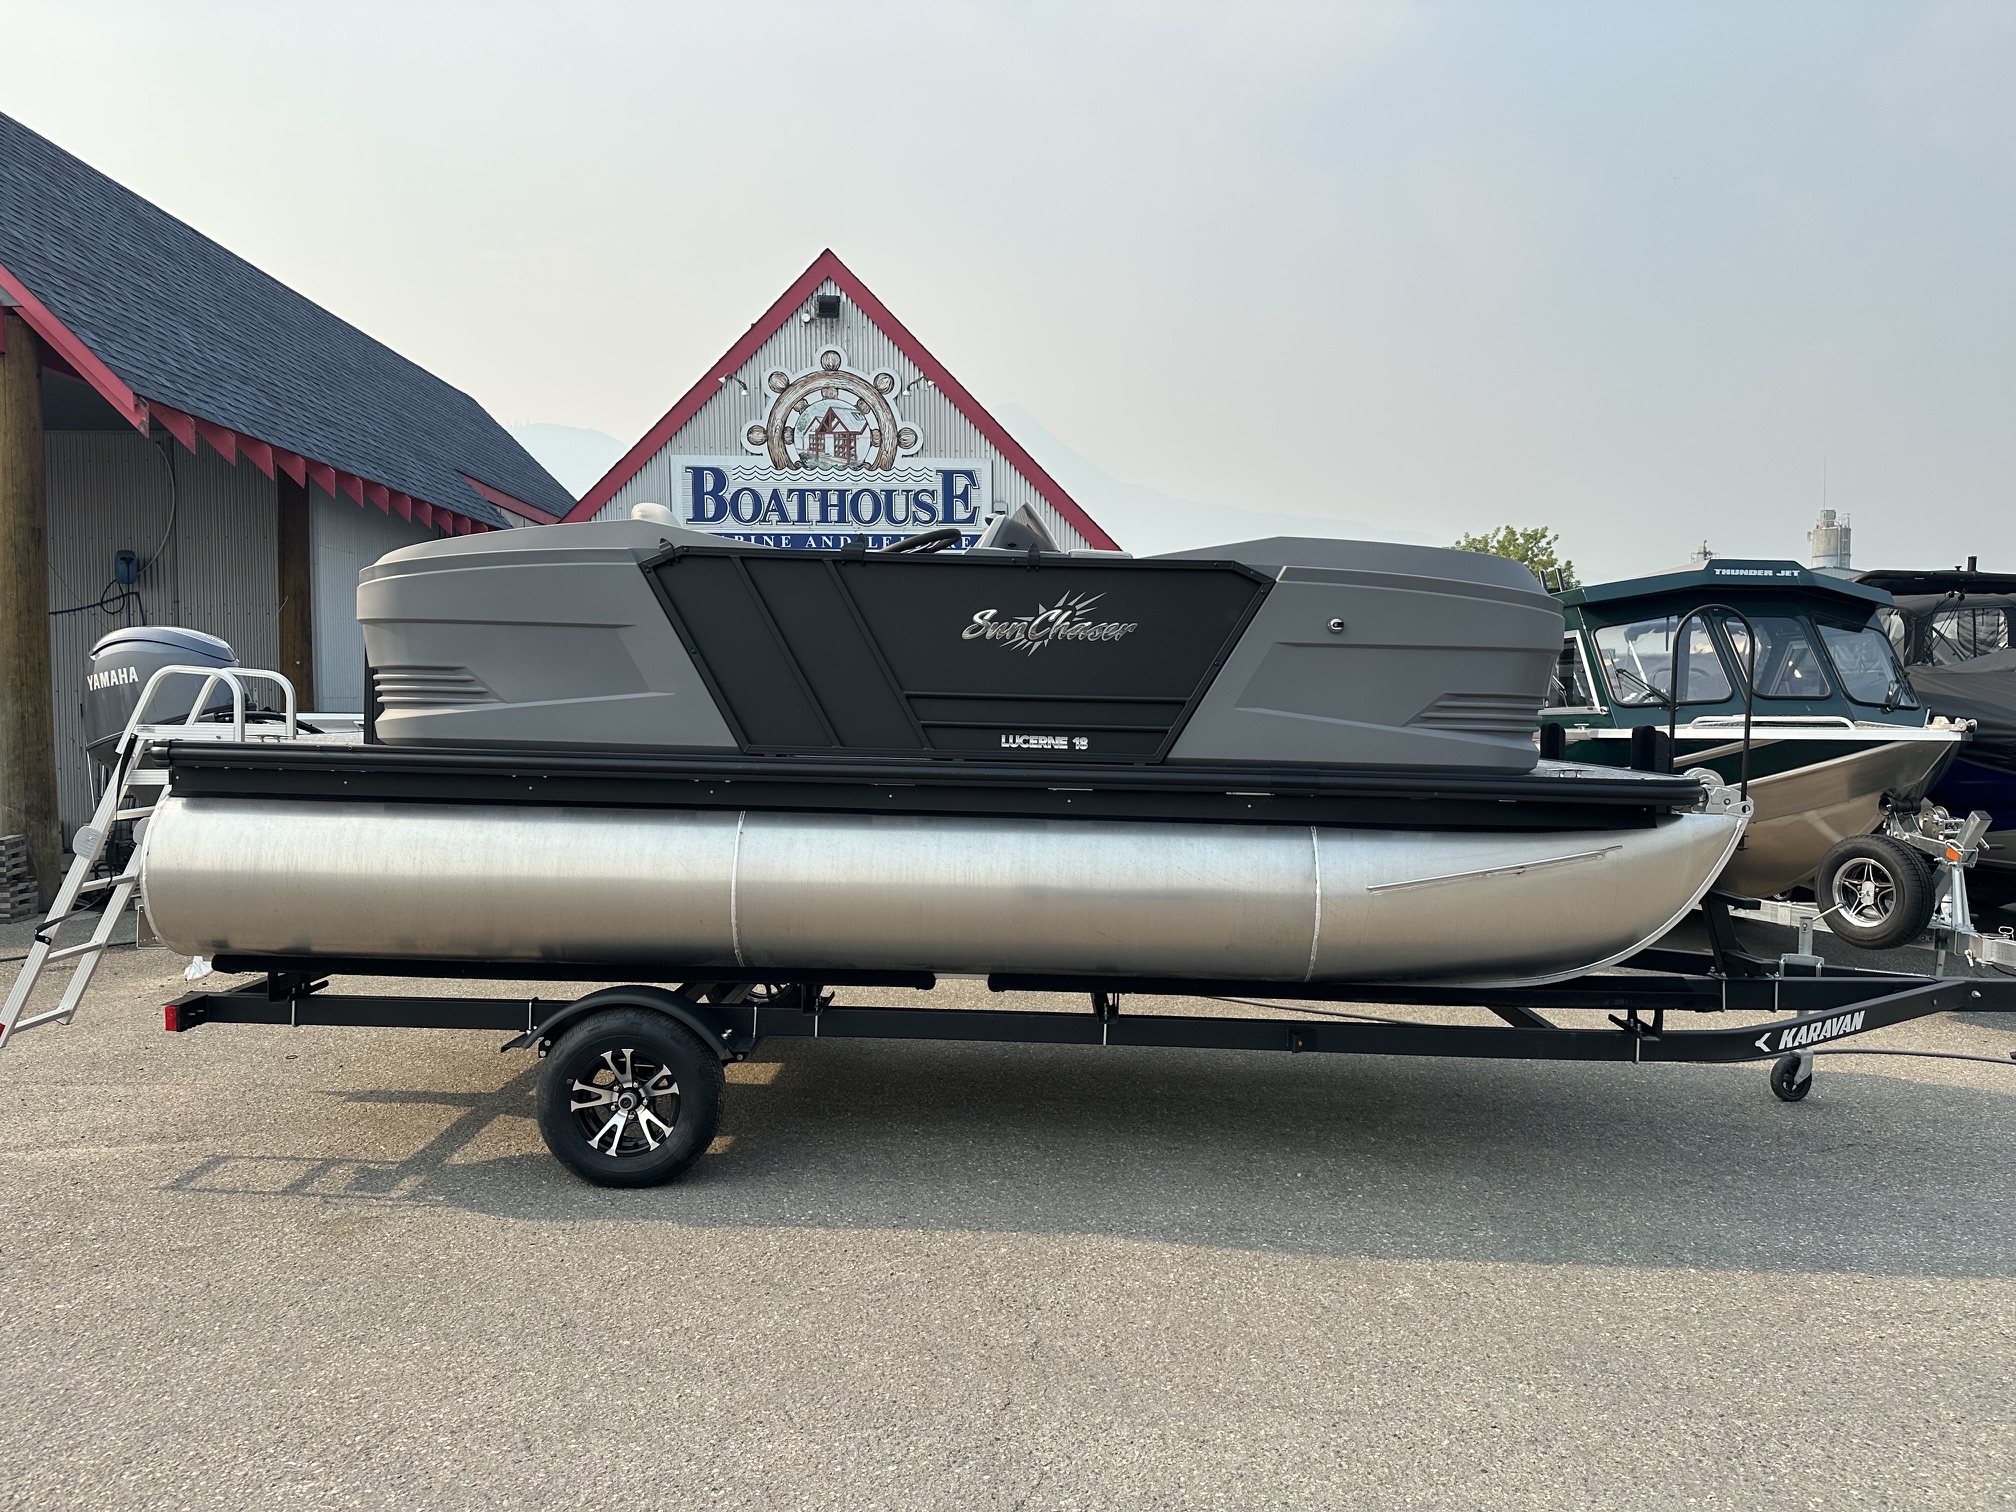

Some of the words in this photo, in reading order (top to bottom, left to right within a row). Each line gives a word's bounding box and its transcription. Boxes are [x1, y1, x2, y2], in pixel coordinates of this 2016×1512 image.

[685, 466, 980, 527] BOATHOUSE
[721, 535, 792, 548] INE
[805, 536, 852, 548] AND
[1714, 568, 1774, 576] THUNDER
[1776, 569, 1801, 577] JET
[961, 608, 1138, 642] SunChaser
[86, 666, 139, 692] YAMAHA
[1001, 734, 1069, 750] LUCERNE
[1072, 736, 1089, 750] 18
[1778, 1010, 1866, 1050] KARAVAN
